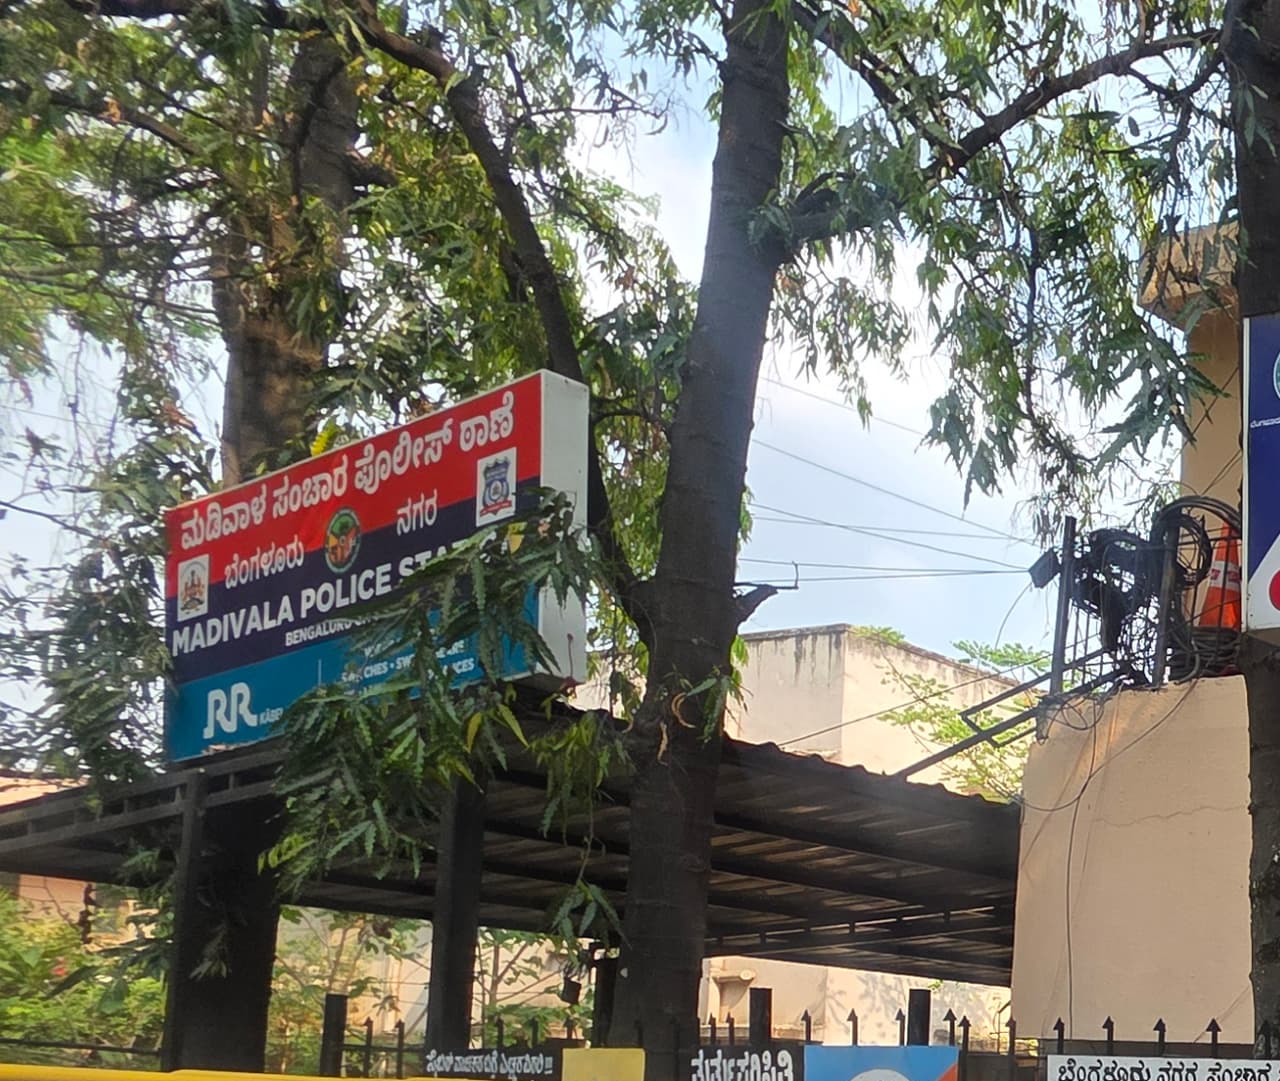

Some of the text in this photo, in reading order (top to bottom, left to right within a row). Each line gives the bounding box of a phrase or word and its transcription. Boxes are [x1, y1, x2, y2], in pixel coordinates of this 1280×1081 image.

[181, 391, 514, 549] ಮಡಿವಾಳ ಸಂಚಾರ ಪೊಲೀಸ್ ಠಾಣೆ
[224, 488, 438, 589] ಬೆಂಗಳೂರು ನಗರ
[172, 595, 295, 656] MADIVALA
[300, 563, 392, 619] POLICE
[203, 682, 258, 739] RR
